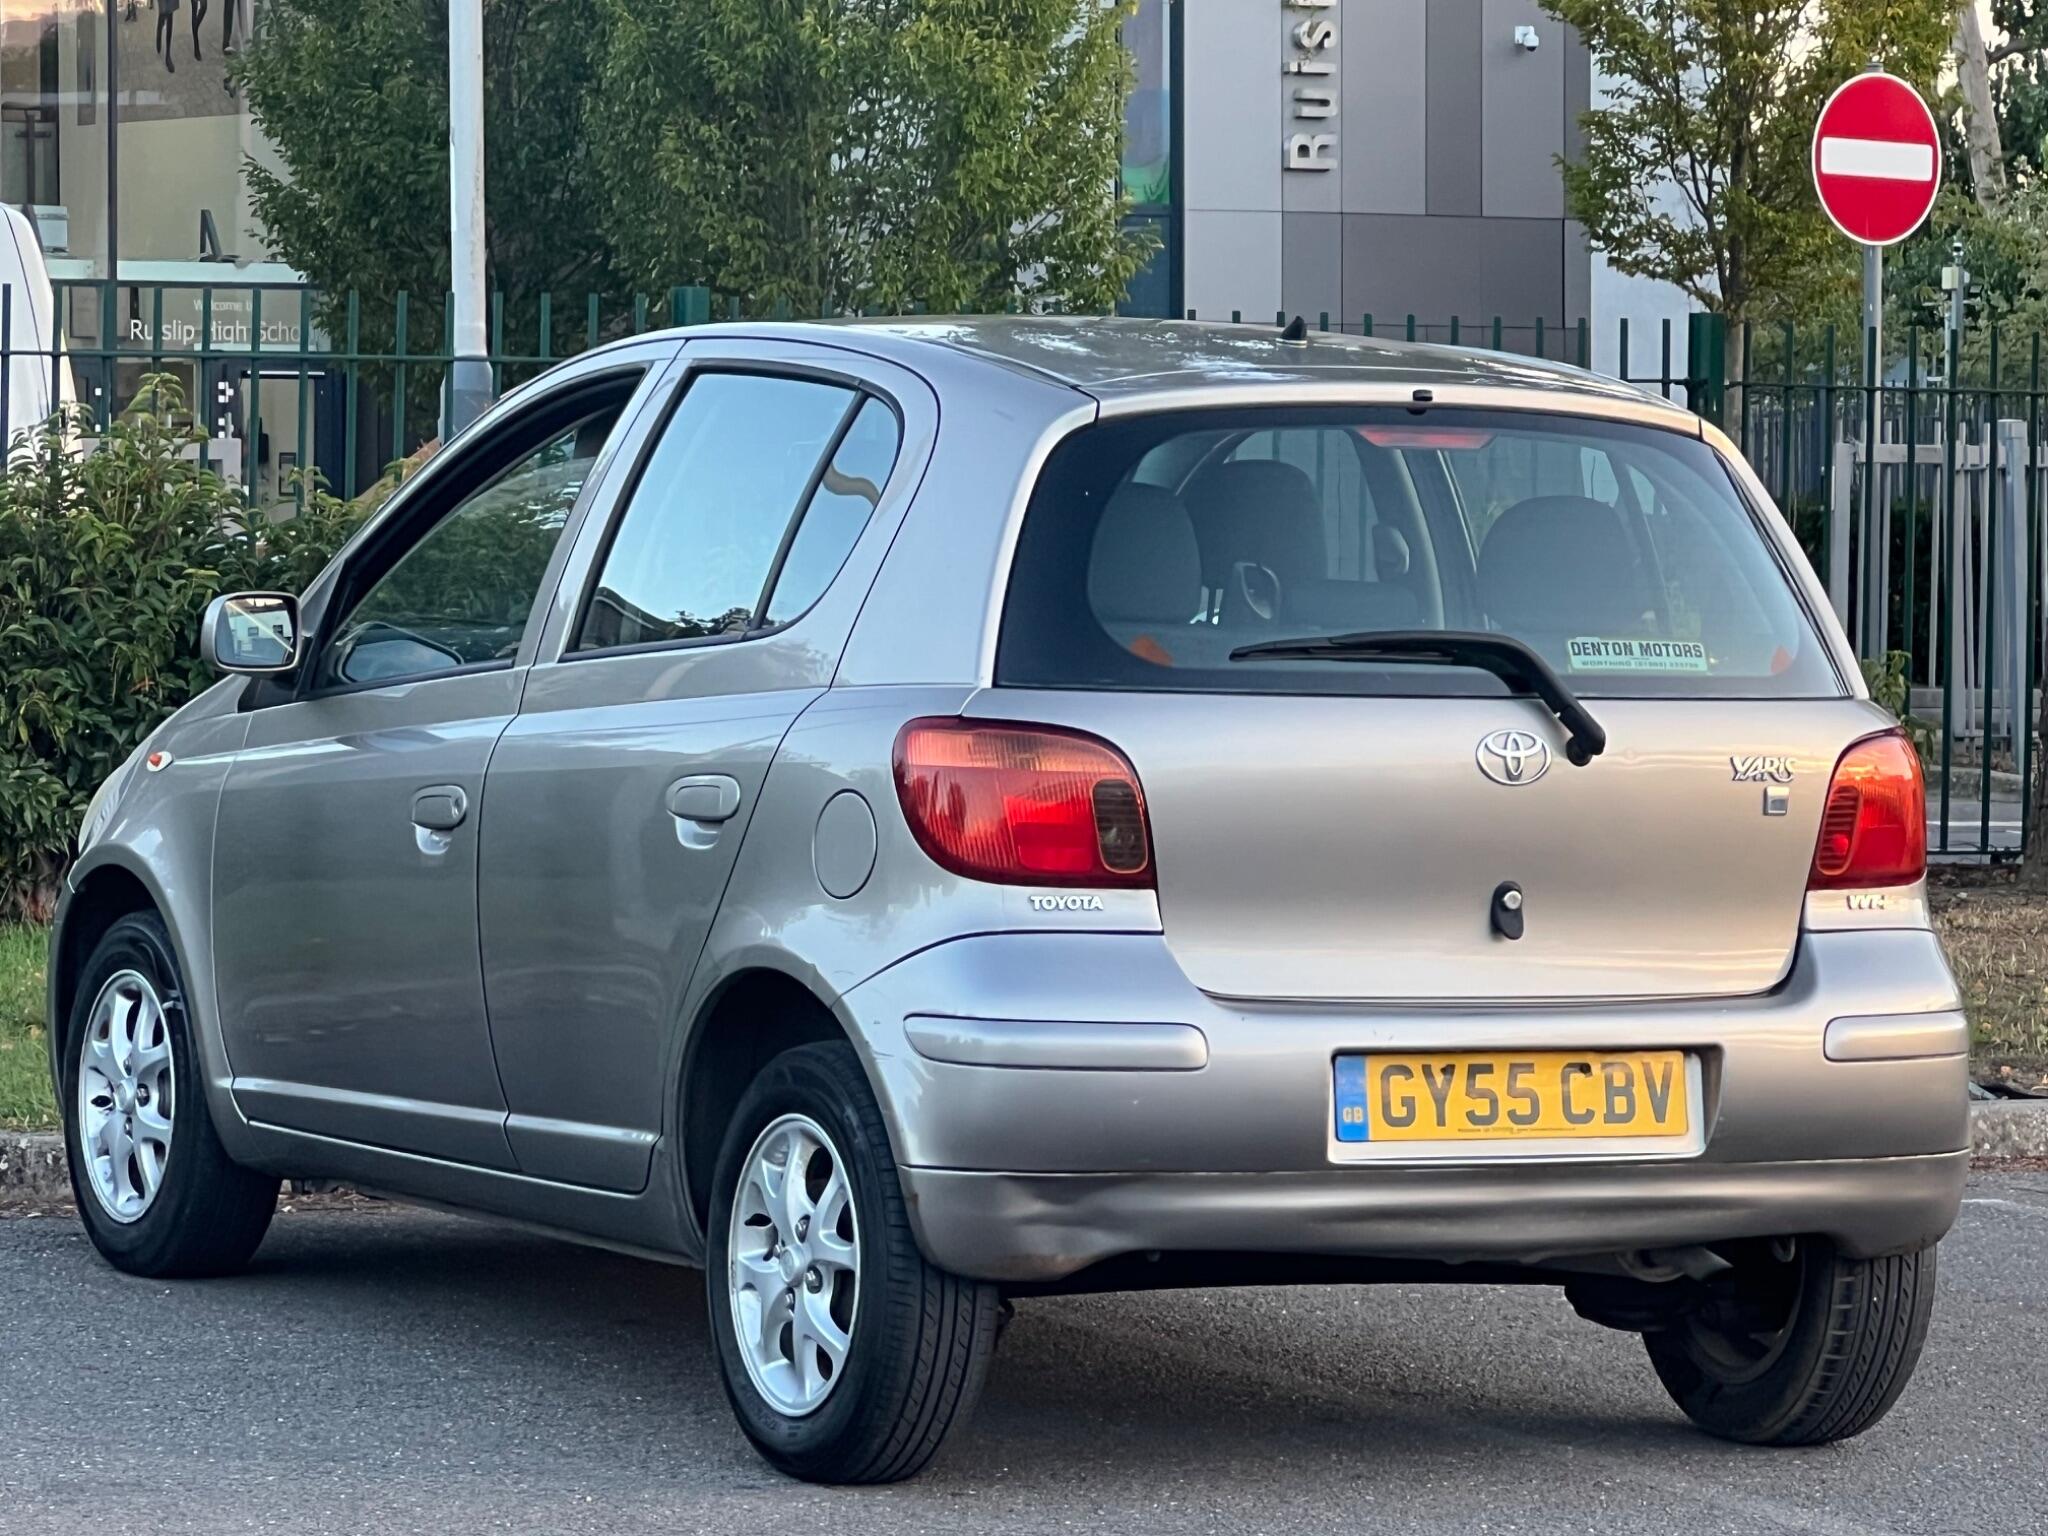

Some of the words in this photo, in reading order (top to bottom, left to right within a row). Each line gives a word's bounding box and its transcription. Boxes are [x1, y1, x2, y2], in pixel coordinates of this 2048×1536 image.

[130, 319, 195, 345] Ruslip
[1571, 641, 1634, 657] DENTON
[1638, 642, 1704, 658] MOTORS
[1029, 895, 1104, 911] TOYOTA
[1379, 1062, 1540, 1128] GY55
[1560, 1060, 1674, 1125] CBV
[1342, 1106, 1363, 1123] GB
